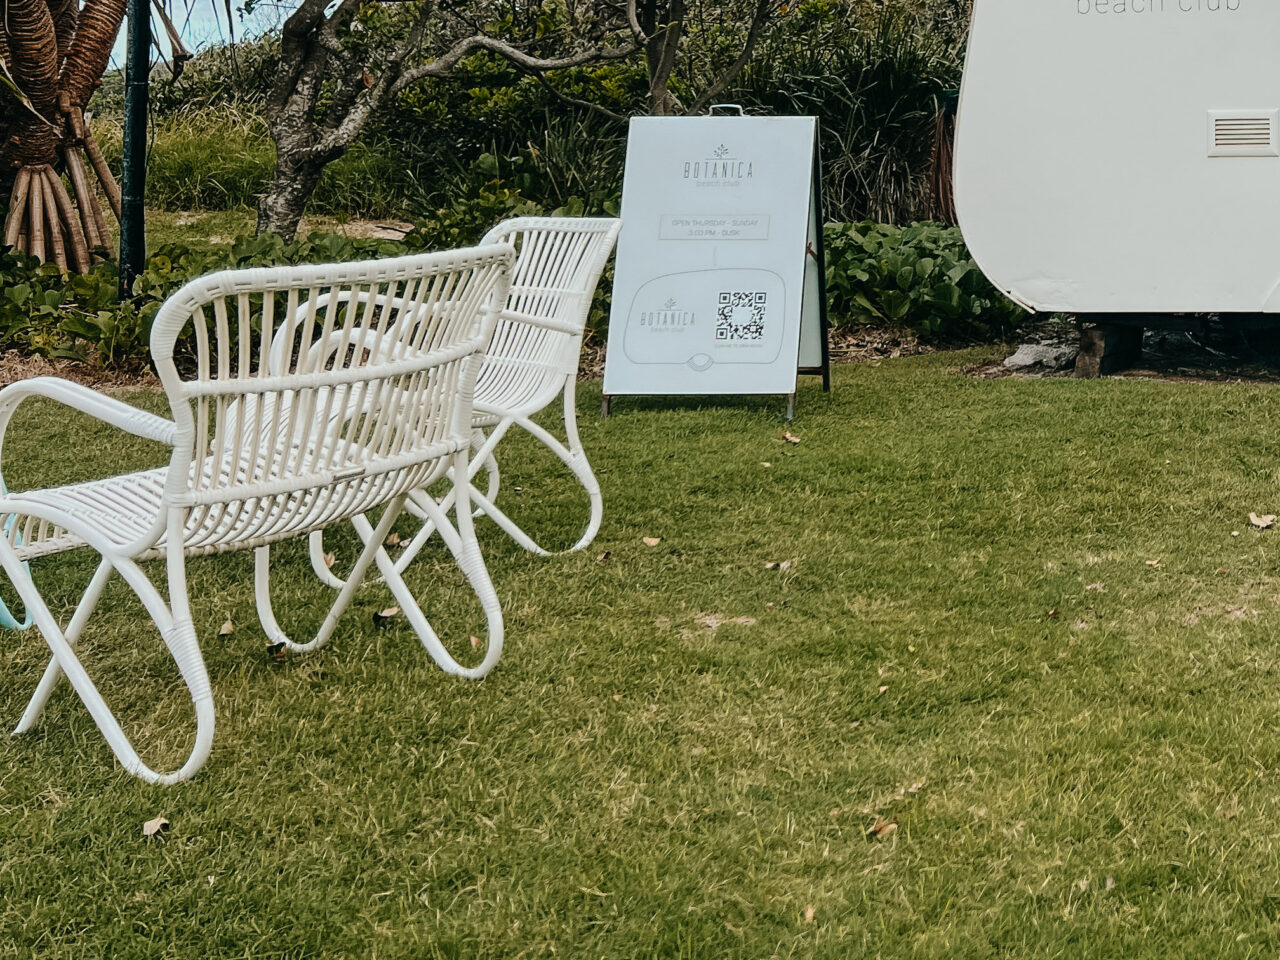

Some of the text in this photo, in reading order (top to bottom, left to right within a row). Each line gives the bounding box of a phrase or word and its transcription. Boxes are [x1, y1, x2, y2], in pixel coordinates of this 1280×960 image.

[683, 161, 754, 179] BOTANICA
[672, 219, 690, 227] OPEN
[692, 219, 727, 227] THURSDAY
[732, 219, 759, 227] SUNDAY
[640, 311, 696, 326] BOTANICA
